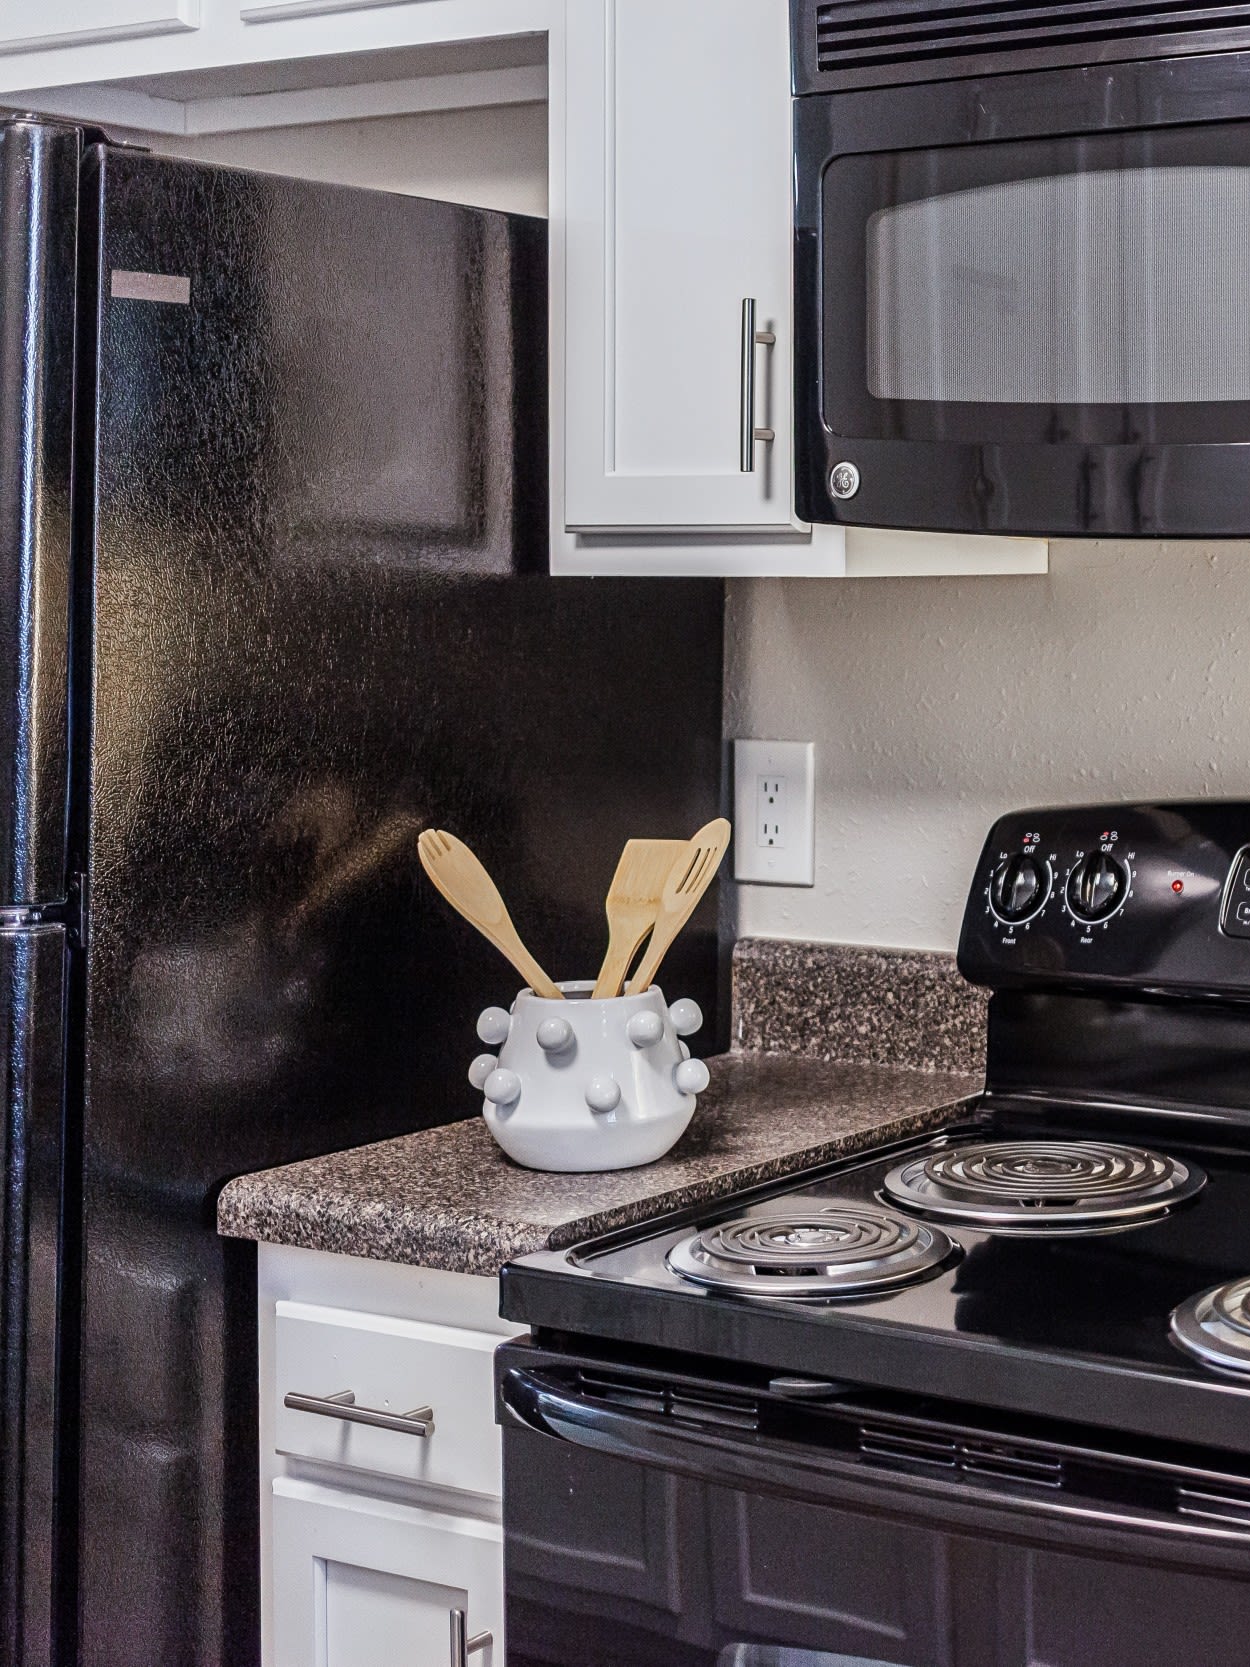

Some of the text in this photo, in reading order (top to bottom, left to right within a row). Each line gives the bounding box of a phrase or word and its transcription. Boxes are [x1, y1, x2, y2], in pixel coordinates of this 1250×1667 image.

[1024, 845, 1036, 854] Off
[1101, 844, 1113, 852] Off
[1050, 853, 1057, 861] Hi
[1076, 851, 1084, 859] Lo
[1128, 852, 1136, 860] Hi
[1002, 937, 1016, 945] Front
[1080, 936, 1093, 944] Rear
